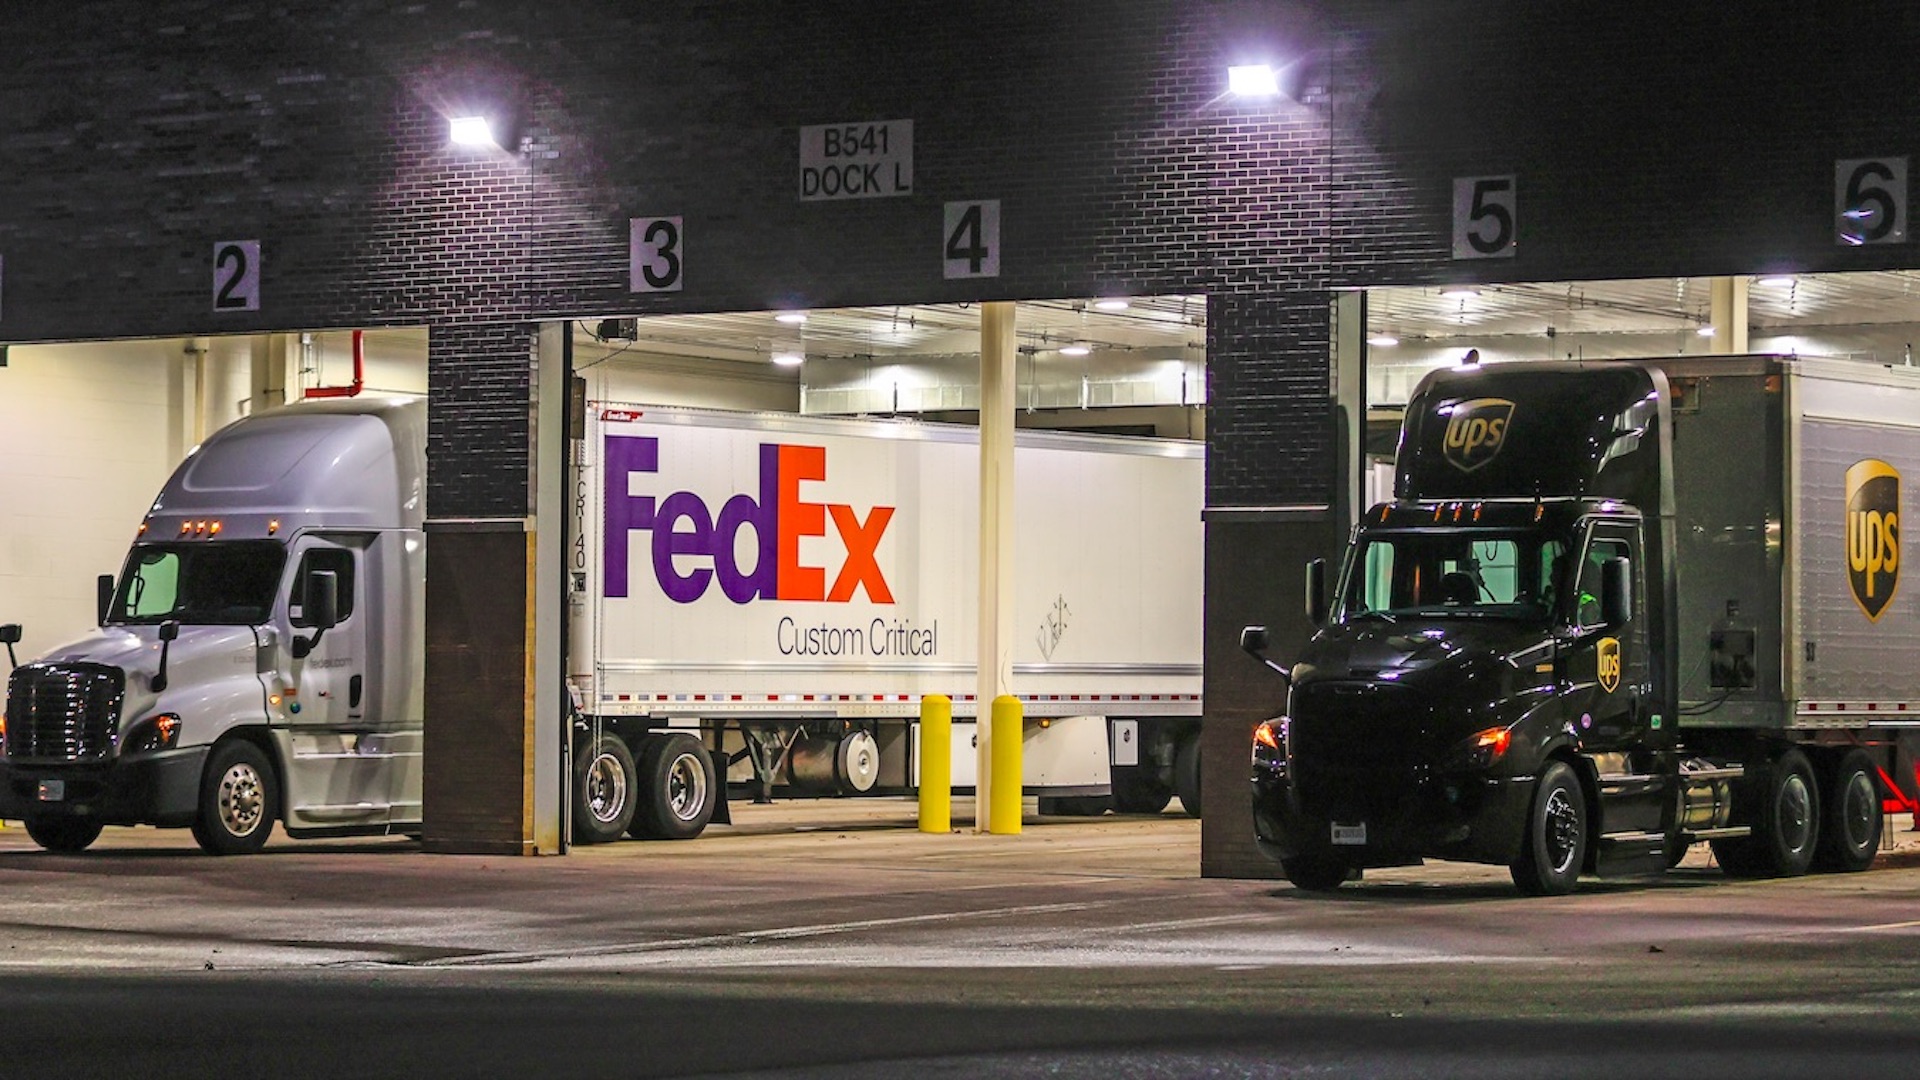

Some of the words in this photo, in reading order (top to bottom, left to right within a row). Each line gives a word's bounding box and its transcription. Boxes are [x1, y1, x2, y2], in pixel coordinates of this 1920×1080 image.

[824, 125, 889, 158] B541
[803, 163, 881, 197] DOCK
[894, 160, 909, 192] L
[1844, 161, 1896, 242] 6
[946, 204, 988, 273] 4
[1466, 179, 1513, 254] 5
[215, 245, 247, 308] 2
[642, 220, 680, 289] 3
[1448, 417, 1506, 458] ups
[603, 434, 896, 605] FedEx
[1850, 509, 1898, 598] ups
[777, 615, 864, 656] Custom
[869, 617, 937, 656] Critical
[1599, 654, 1619, 686] ups
